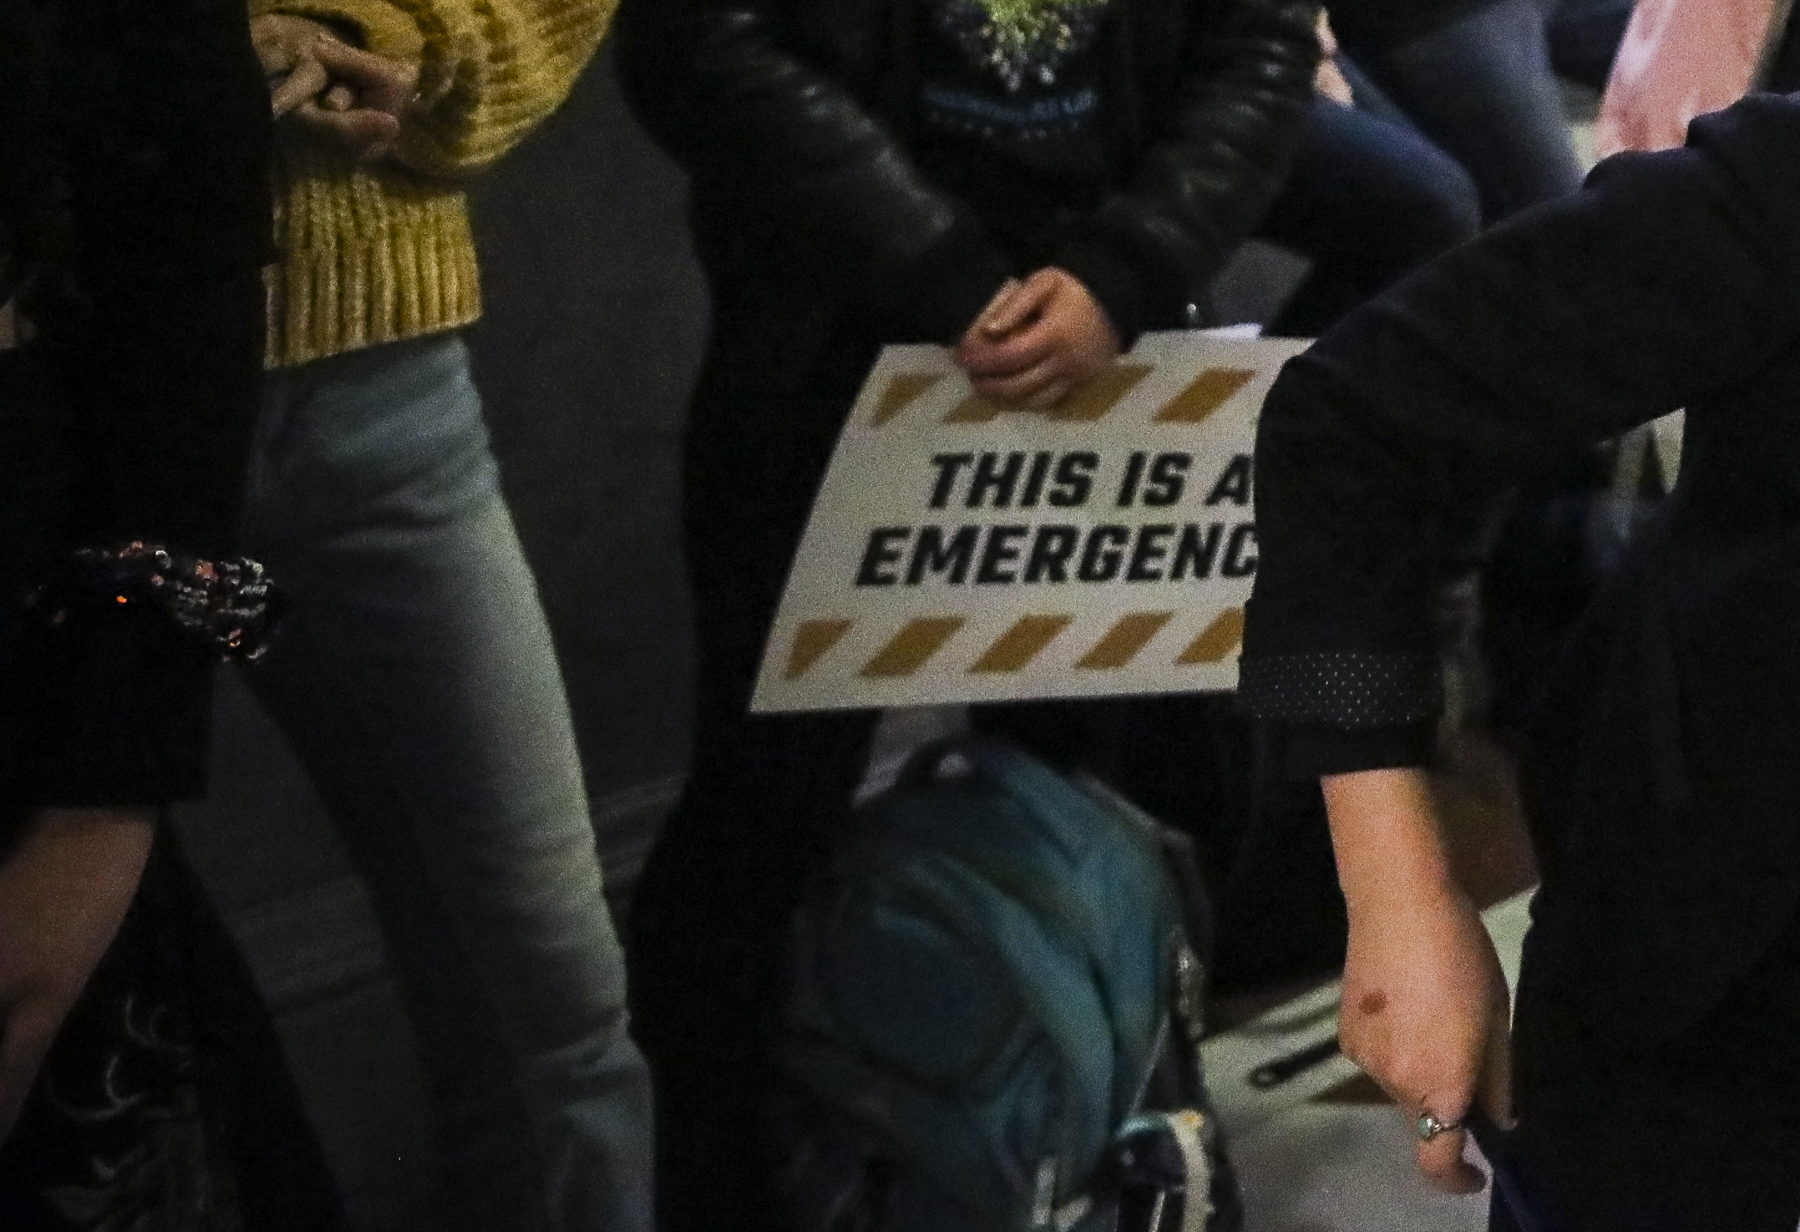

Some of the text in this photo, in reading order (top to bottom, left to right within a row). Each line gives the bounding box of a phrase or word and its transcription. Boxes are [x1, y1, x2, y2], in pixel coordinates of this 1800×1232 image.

[928, 452, 1099, 508] THIS
[1117, 452, 1192, 508] IS
[855, 523, 1258, 587] EMERGENC
